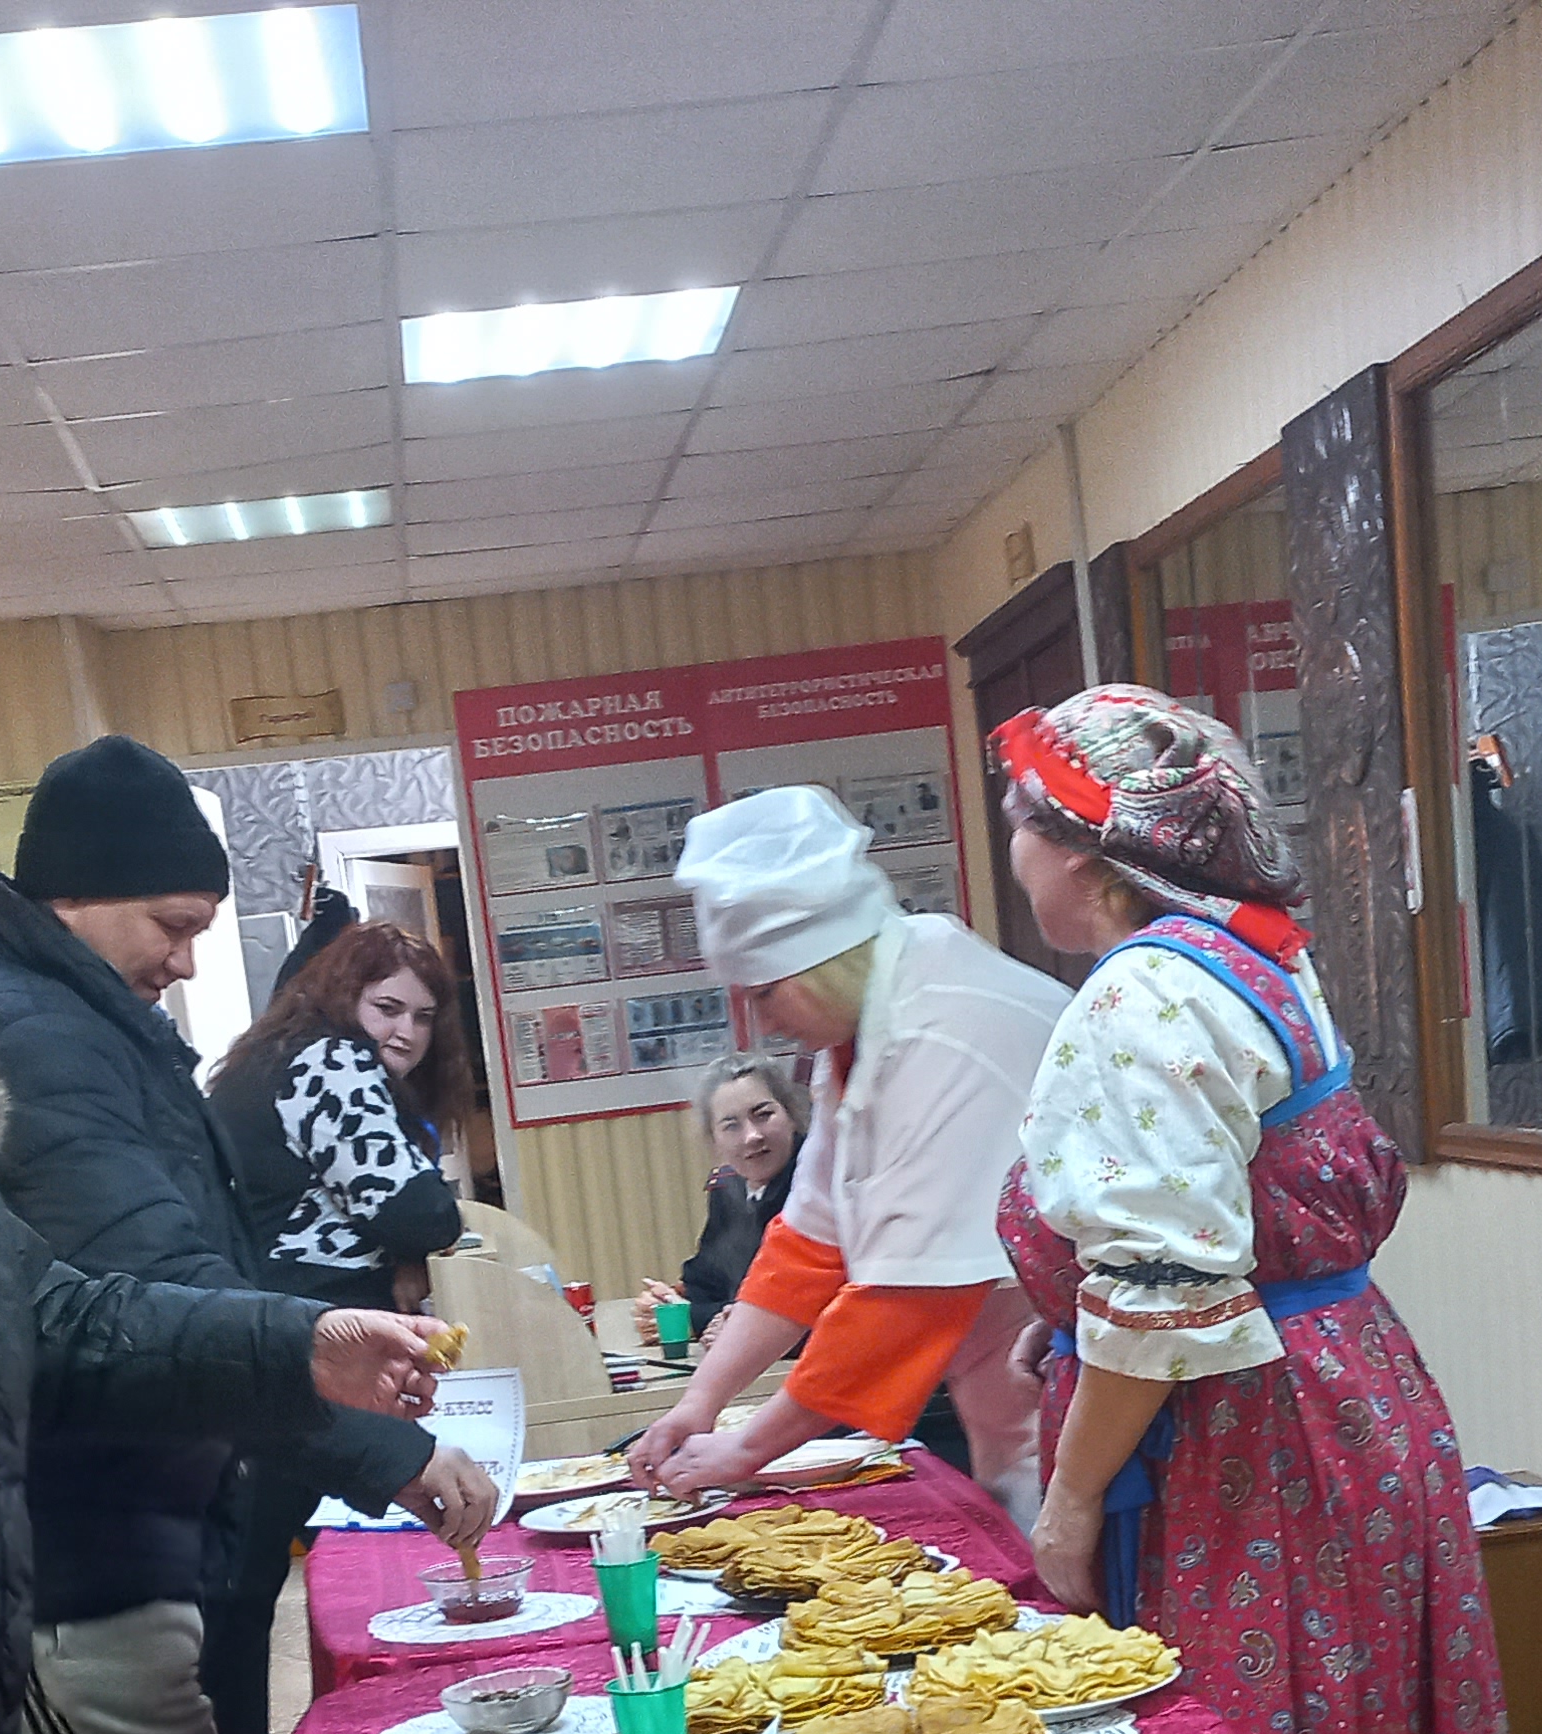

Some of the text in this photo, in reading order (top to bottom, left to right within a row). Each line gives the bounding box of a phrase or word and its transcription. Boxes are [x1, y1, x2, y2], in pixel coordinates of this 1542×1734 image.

[497, 690, 663, 727] ПОЖАРНАЯ
[759, 690, 898, 718] БЕЗОПАСНОСТЬ
[471, 717, 694, 759] БЕЗОПАСНОСТЬ
